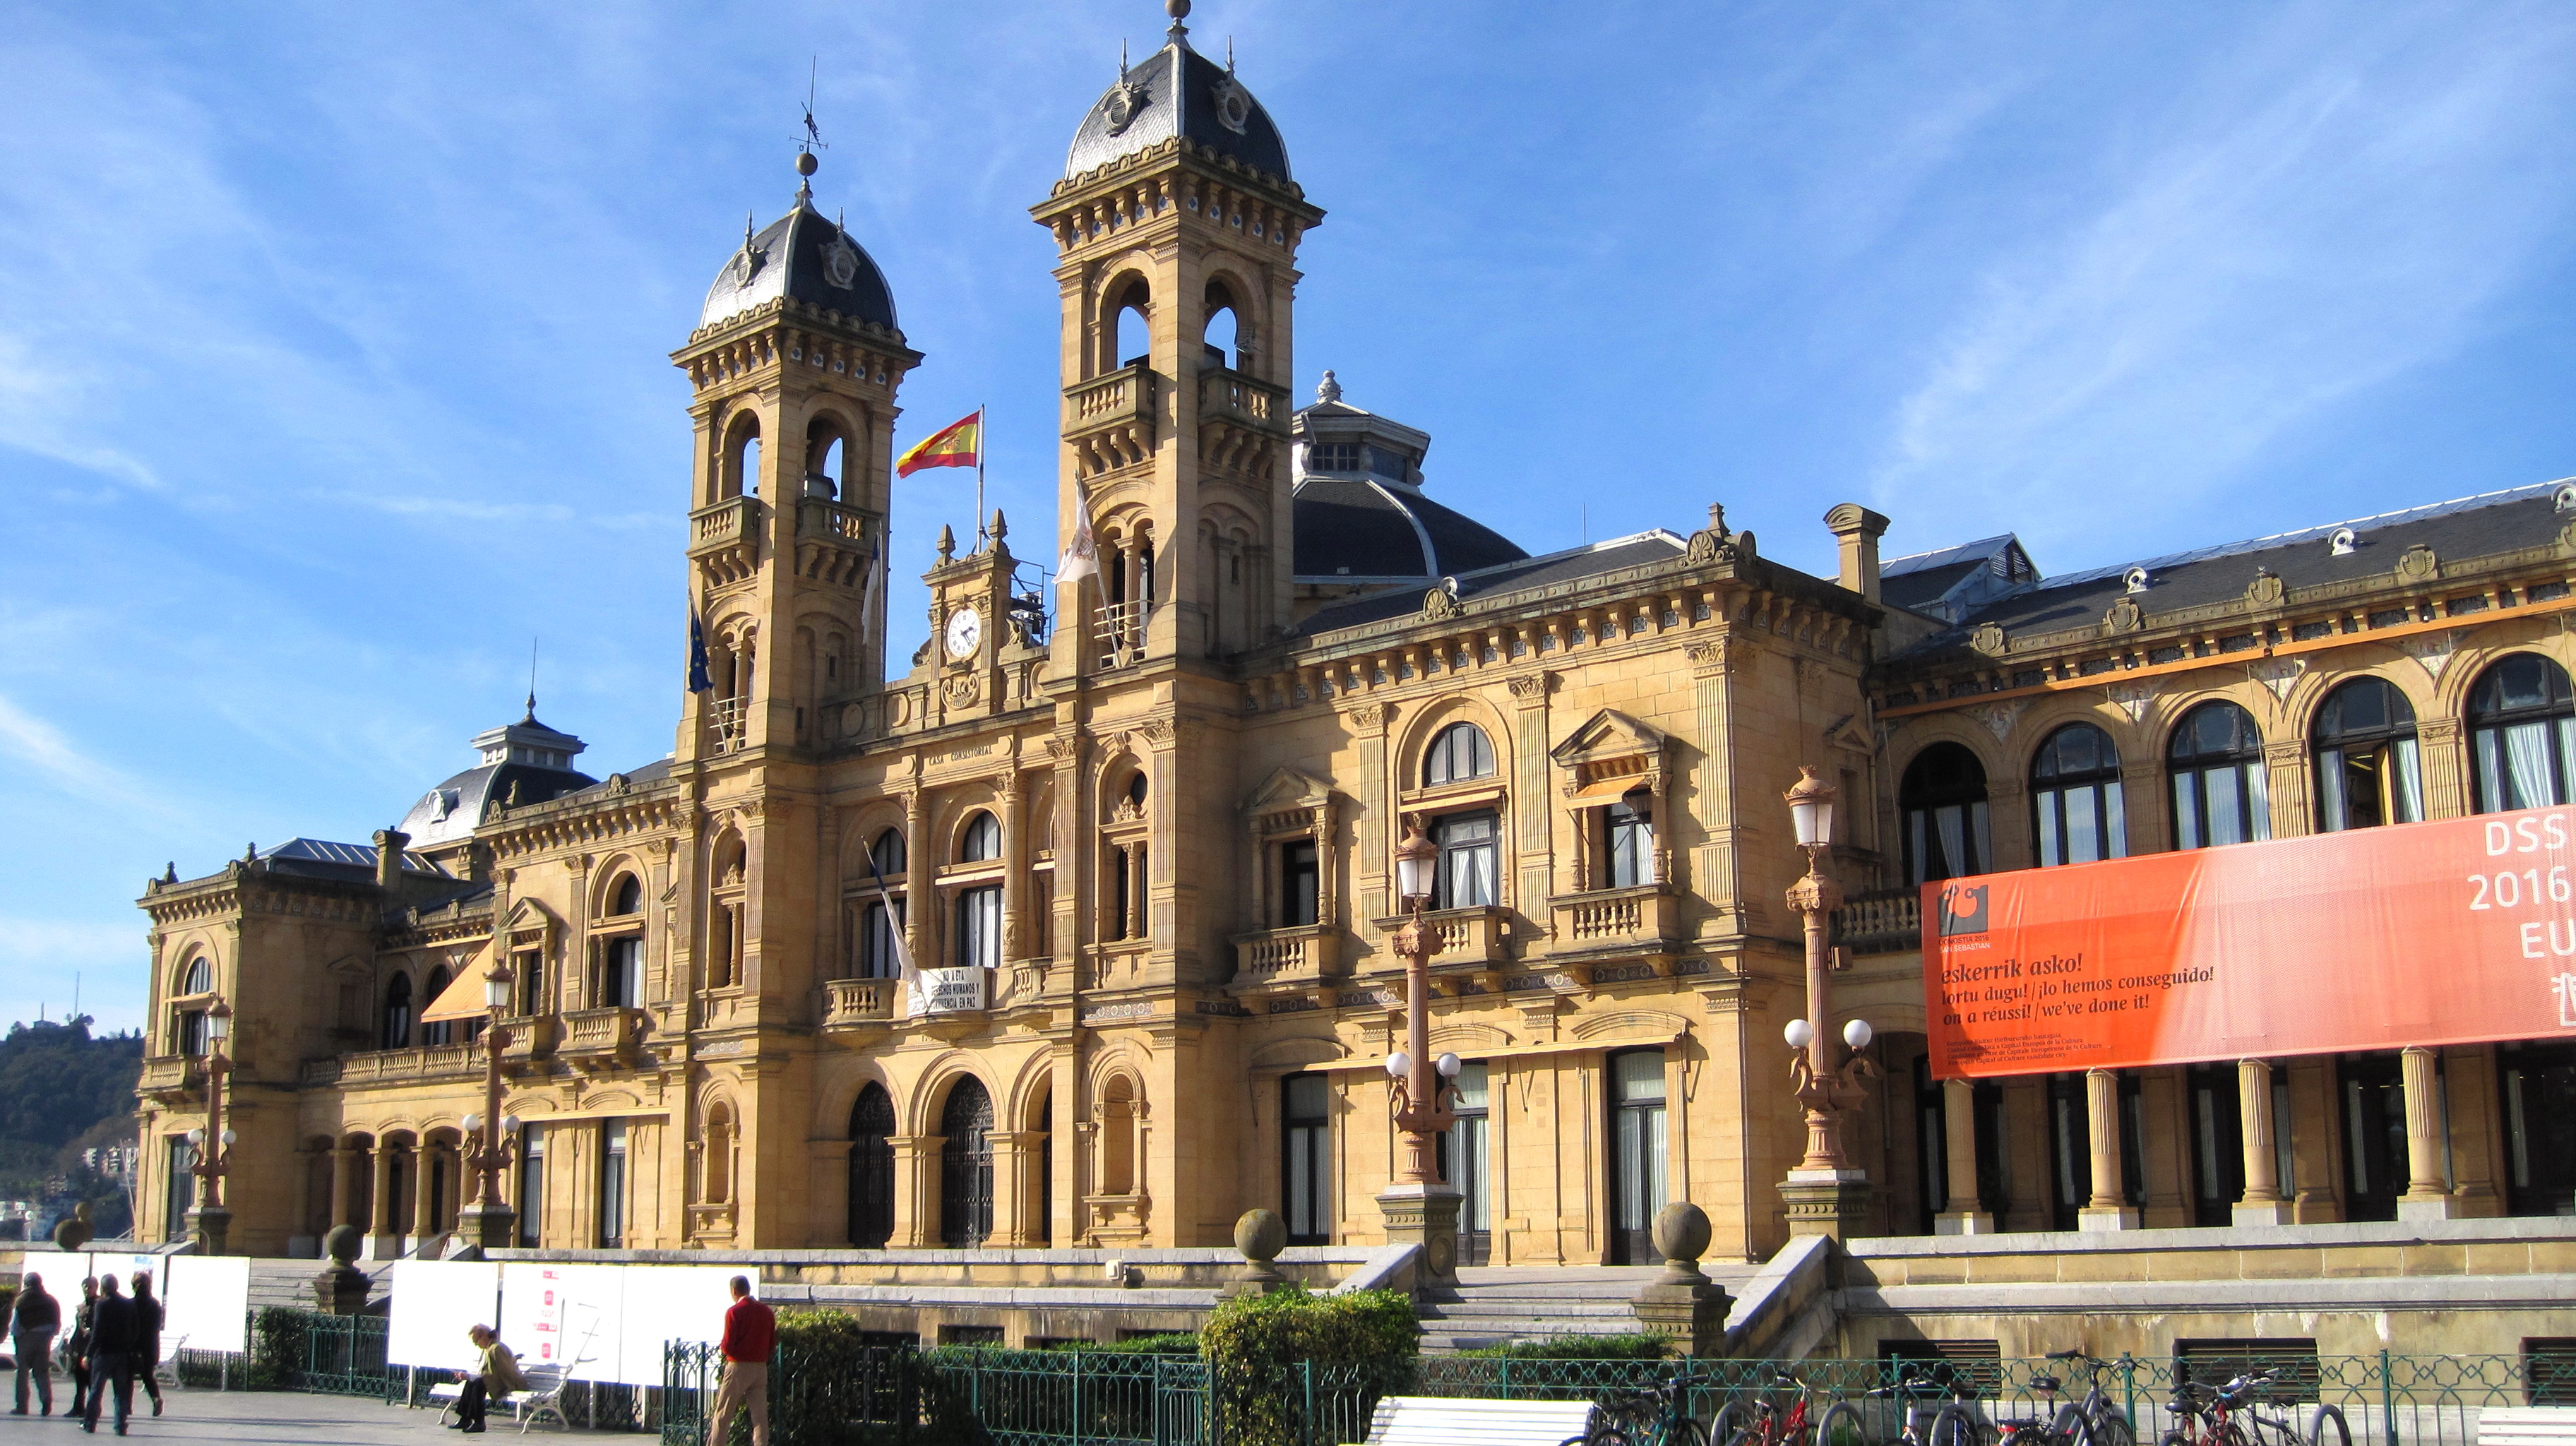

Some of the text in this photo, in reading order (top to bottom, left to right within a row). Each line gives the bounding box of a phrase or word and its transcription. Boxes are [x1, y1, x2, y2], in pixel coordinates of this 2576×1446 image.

[929, 745, 992, 765] CASA CONSISTORIAL
[2484, 813, 2567, 856] DSS
[2467, 865, 2571, 910] 2016
[1938, 943, 1991, 953] SAN SEBASTIAN
[1939, 936, 1973, 945] DONOSTIA
[2520, 918, 2576, 958] EU
[956, 969, 965, 981] ETA
[1941, 952, 2082, 984] eskerrik asko!
[976, 982, 979, 993] Y
[1942, 990, 1979, 1005] lortu
[1984, 983, 2027, 1004] dugu!
[2063, 979, 2112, 993] hemos
[2118, 966, 2214, 990] conseguido!
[960, 996, 965, 1008] EN
[967, 996, 976, 1008] PAZ
[1943, 1012, 1961, 1025] on
[1967, 1012, 1976, 1023] a
[1983, 1004, 2031, 1022] réussi!
[2088, 998, 2127, 1013] done
[2133, 993, 2149, 1009] it!
